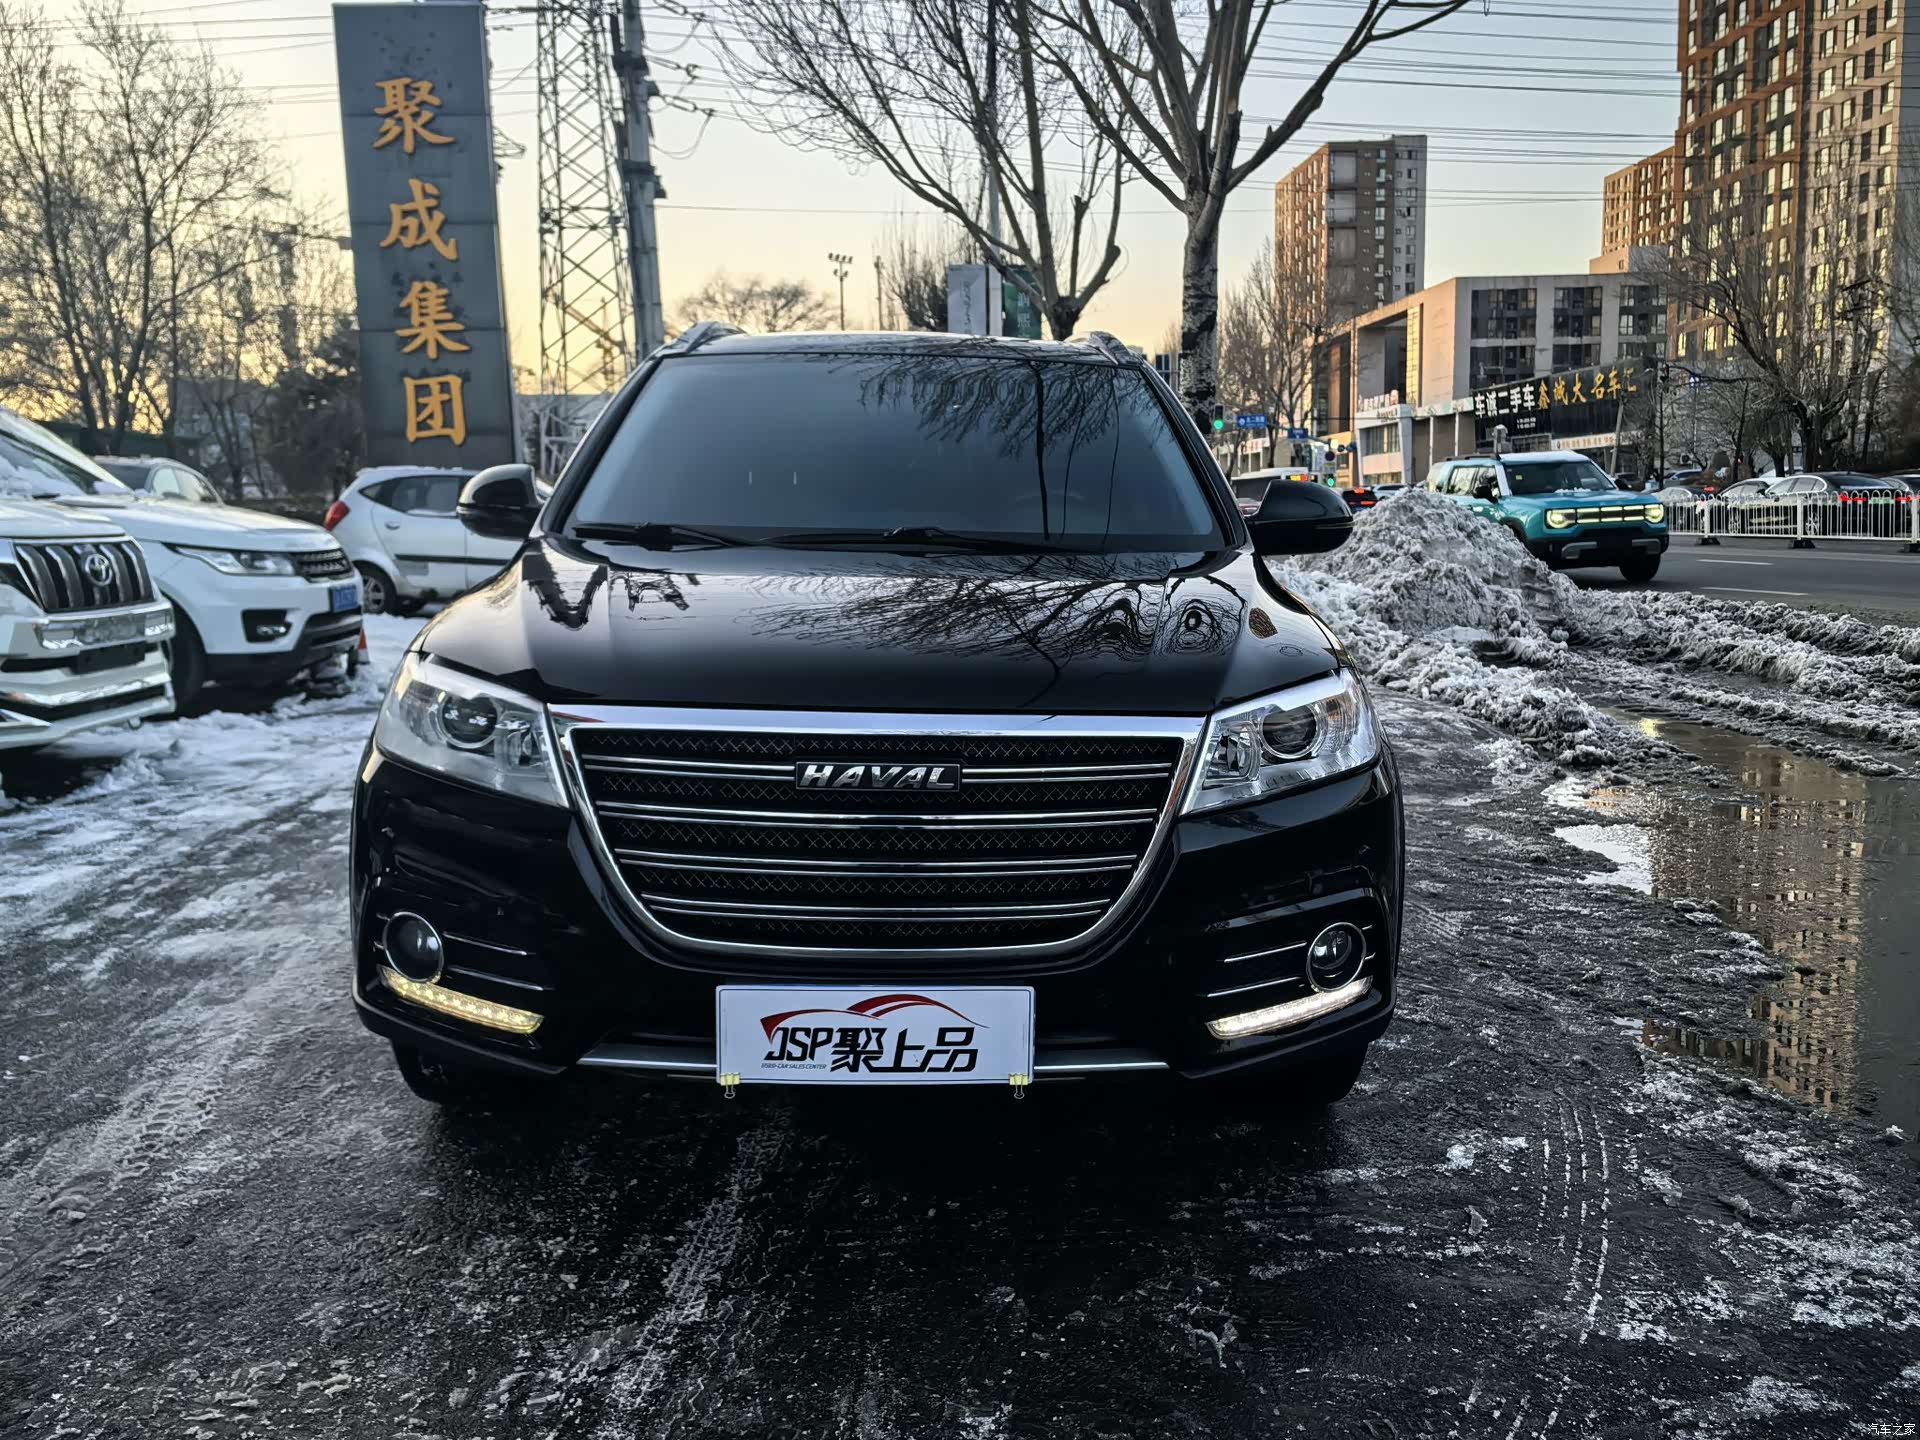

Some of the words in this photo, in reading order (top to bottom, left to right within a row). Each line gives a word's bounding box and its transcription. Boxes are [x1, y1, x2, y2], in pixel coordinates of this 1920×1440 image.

[372, 76, 470, 447] 聚成集团
[800, 764, 955, 789] HAVAL
[764, 1027, 834, 1061] JSP
[830, 1027, 979, 1073] 聚上品
